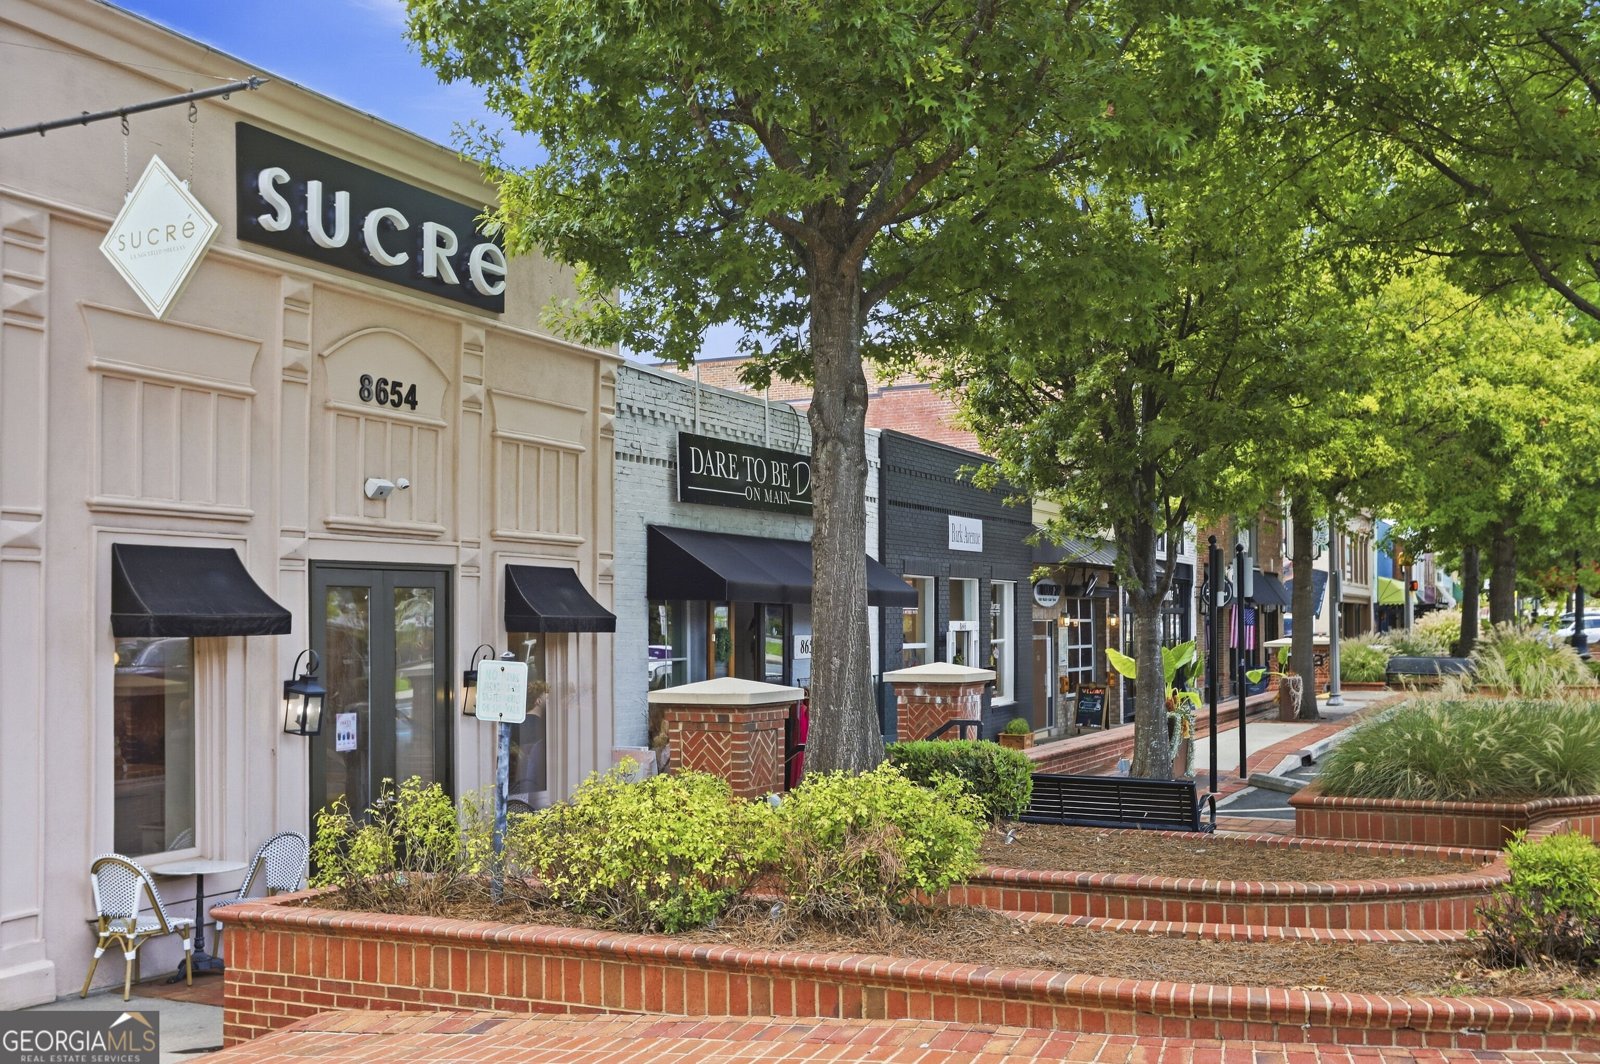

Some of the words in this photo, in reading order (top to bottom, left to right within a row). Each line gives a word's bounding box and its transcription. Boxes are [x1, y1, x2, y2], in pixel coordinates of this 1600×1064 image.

[118, 213, 196, 251] SUCRé
[359, 374, 418, 410] 8654
[690, 446, 739, 480] DARE
[742, 456, 767, 483] TO
[771, 461, 790, 487] BE
[745, 486, 760, 501] ON
[764, 488, 790, 505] MAIN
